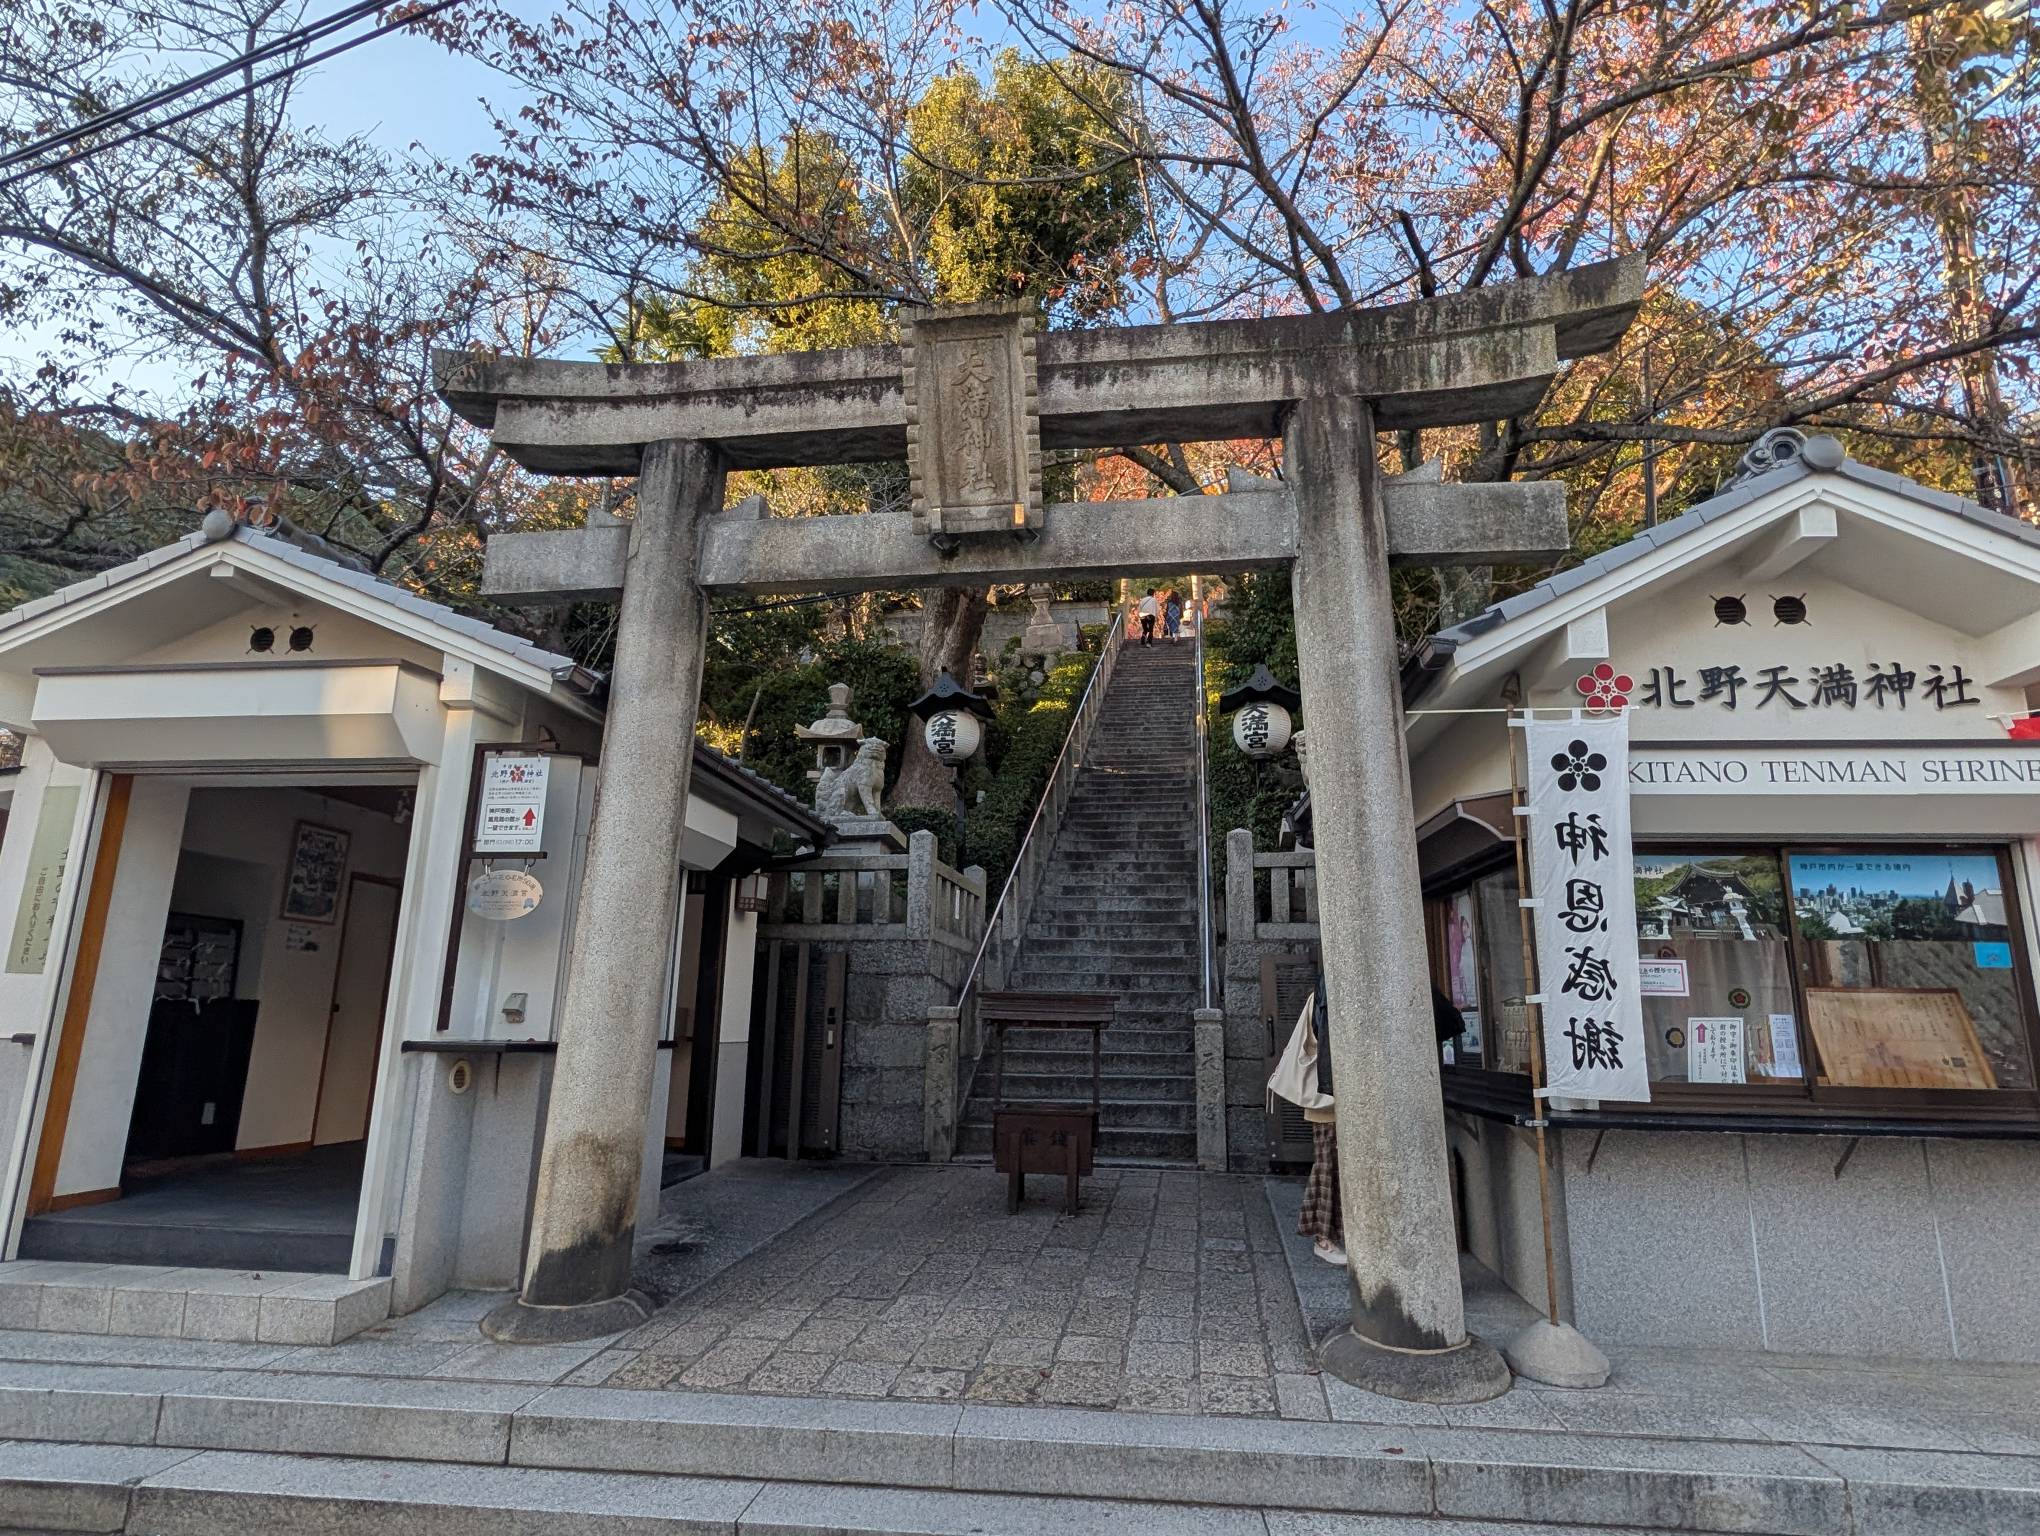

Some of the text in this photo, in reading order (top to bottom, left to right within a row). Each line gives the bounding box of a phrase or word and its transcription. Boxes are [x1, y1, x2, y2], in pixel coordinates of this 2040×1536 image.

[950, 350, 998, 491] 天満神社
[1642, 662, 1982, 710] 北野天満神社
[931, 711, 957, 755] 天満宮
[1241, 704, 1270, 750] 天満宮
[490, 769, 544, 779] 北野神社
[1628, 760, 2040, 784] KITANO TENMAN SHRINE
